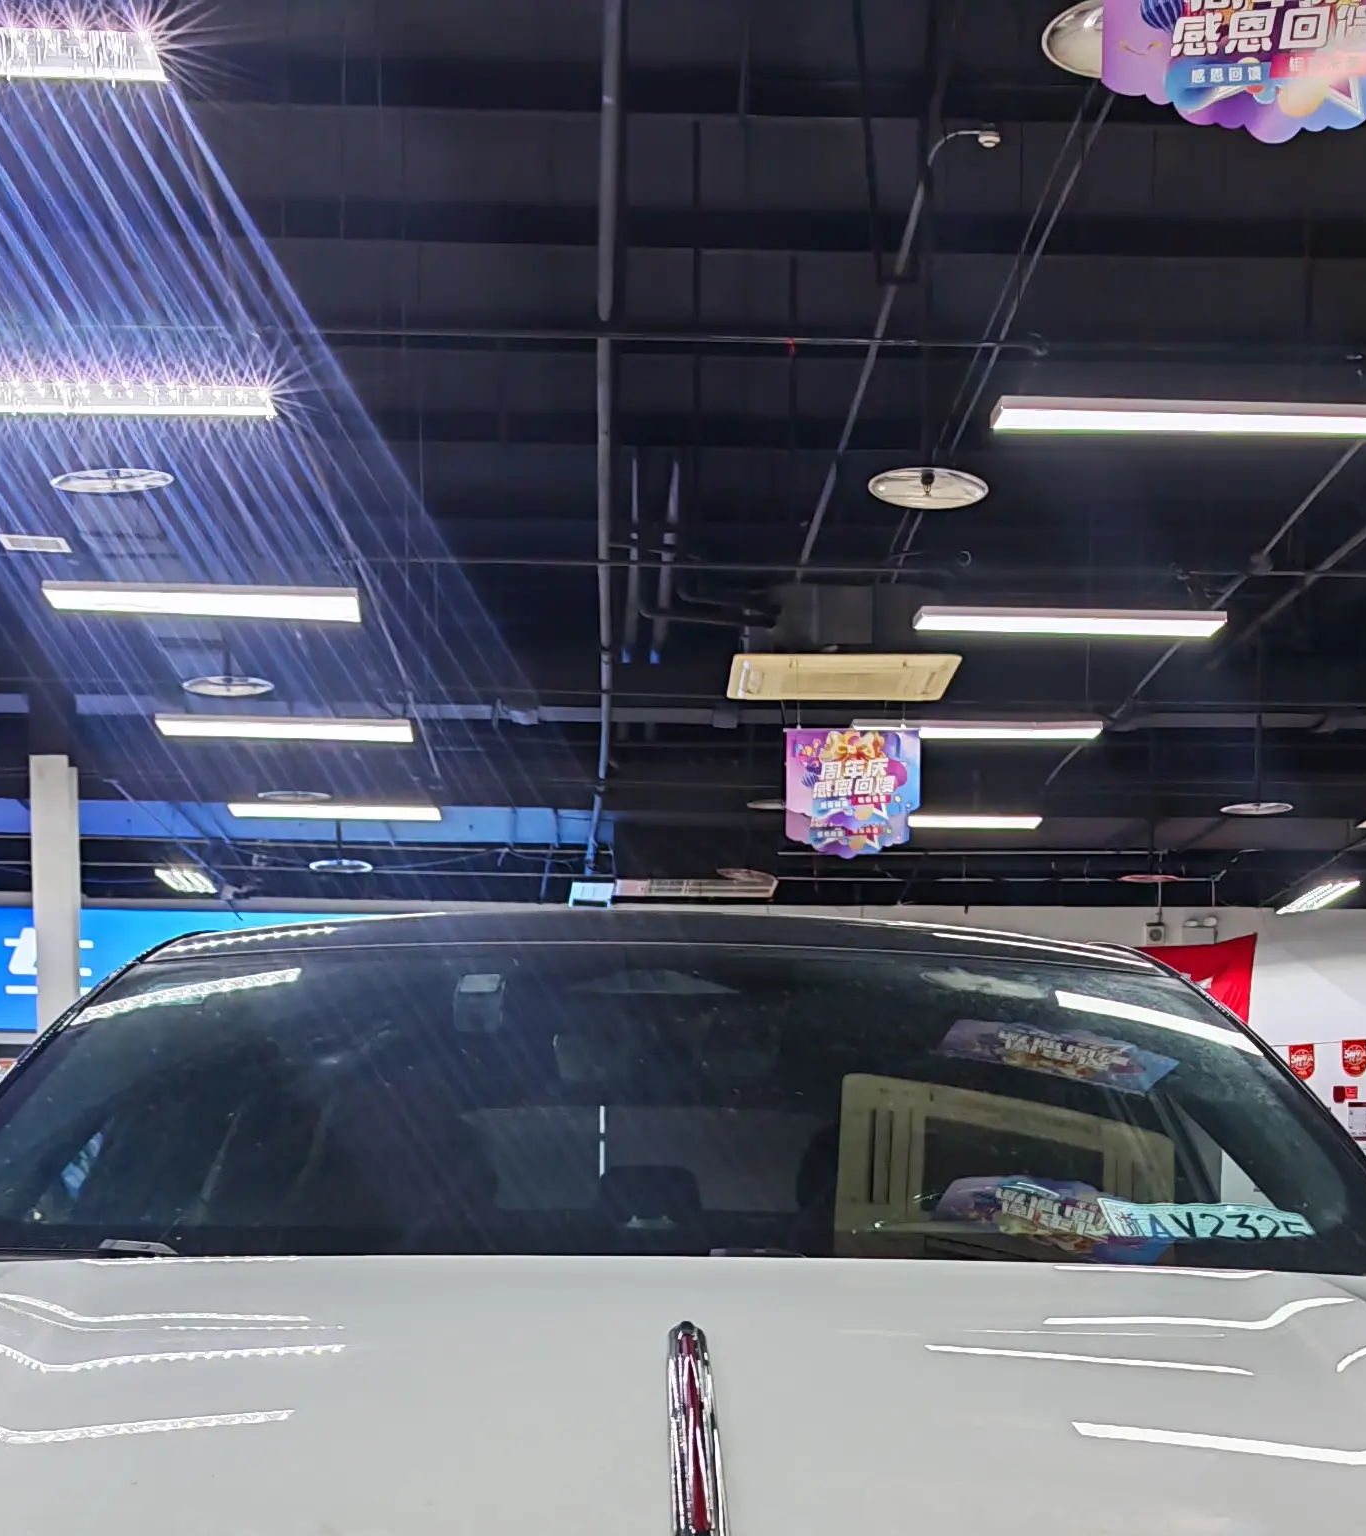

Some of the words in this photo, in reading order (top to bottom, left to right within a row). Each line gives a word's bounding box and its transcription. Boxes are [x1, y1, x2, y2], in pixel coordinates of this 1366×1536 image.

[1190, 66, 1263, 83] 感恩回馈
[820, 758, 889, 780] 周年庆
[812, 776, 896, 798] 感恩回馈
